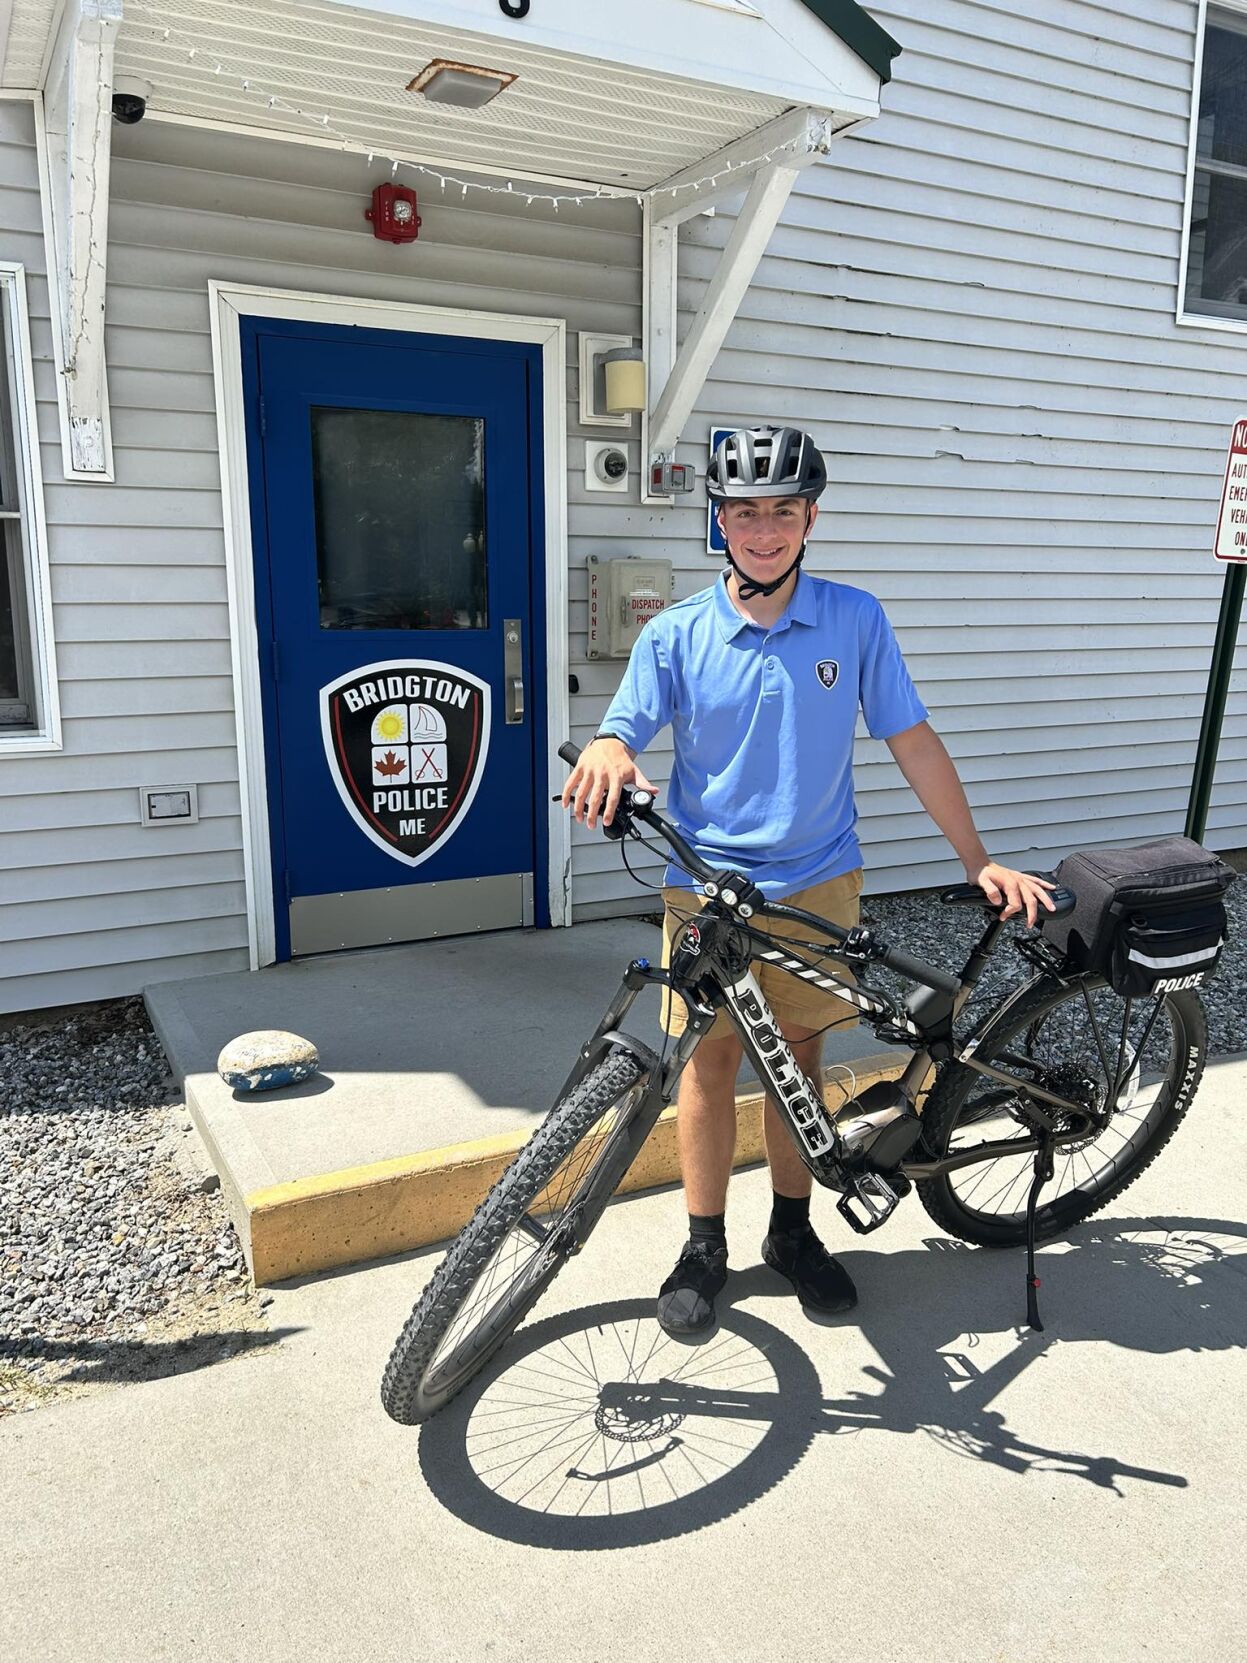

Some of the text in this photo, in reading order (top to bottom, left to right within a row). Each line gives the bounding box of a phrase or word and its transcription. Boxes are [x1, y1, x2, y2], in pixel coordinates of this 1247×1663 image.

[631, 599, 665, 610] DISPATCH
[636, 614, 656, 624] PHO
[342, 675, 471, 713] BRIDGTON
[372, 787, 449, 814] POLICE
[399, 818, 426, 836] ME
[1154, 971, 1205, 994] POLICE
[732, 988, 828, 1151] POLICE
[1174, 1045, 1200, 1112] MAXXIS
